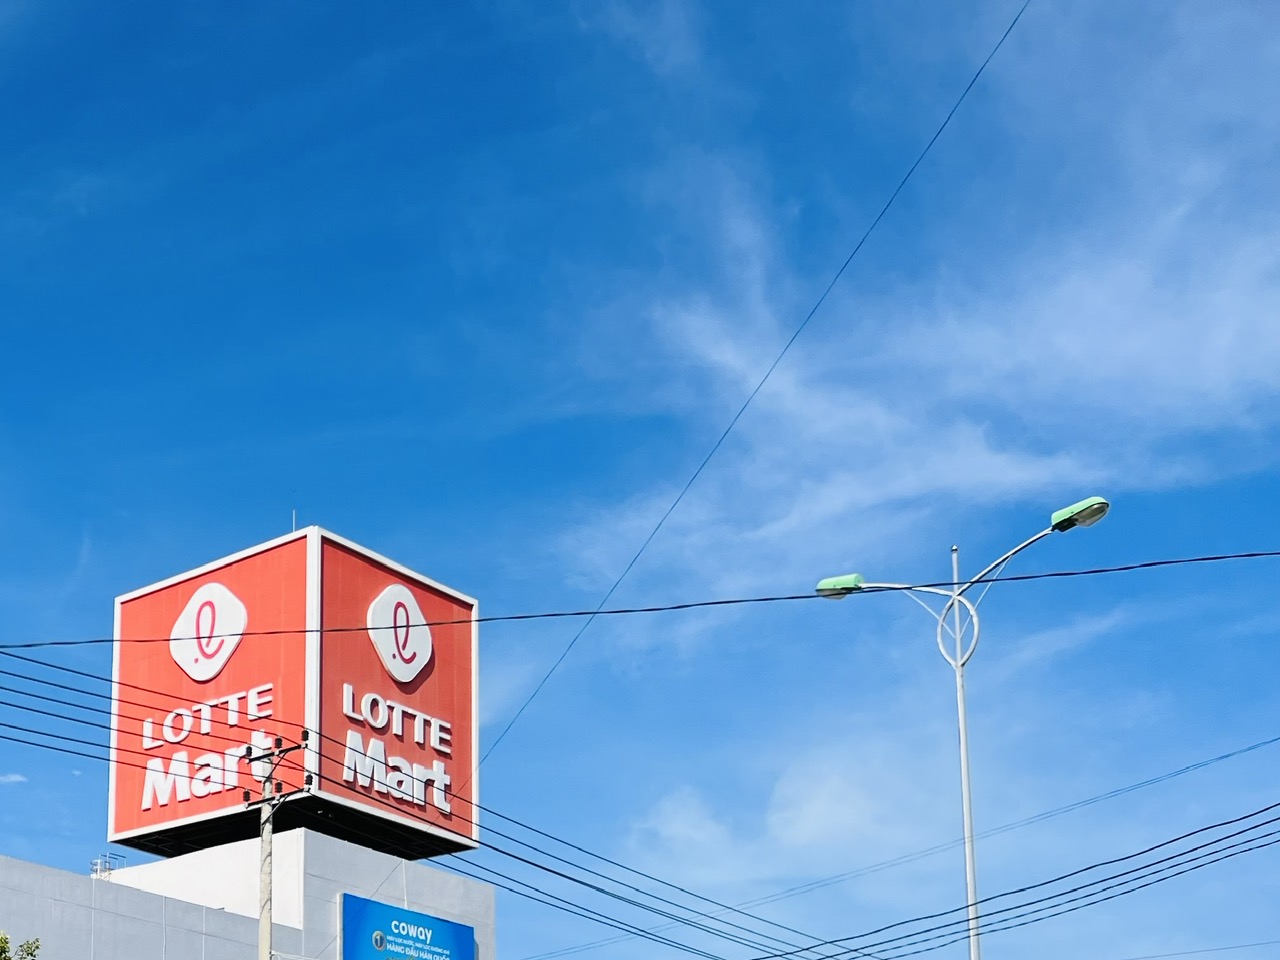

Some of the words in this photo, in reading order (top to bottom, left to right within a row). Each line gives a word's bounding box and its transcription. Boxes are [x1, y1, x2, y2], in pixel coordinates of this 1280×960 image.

[142, 682, 274, 750] LOTTE
[342, 682, 452, 755] LOTTE
[141, 728, 274, 812] Mart
[342, 729, 452, 815] Mart
[386, 942, 405, 954] HÀNG
[419, 950, 433, 960] HÀN
[391, 920, 433, 944] coway
